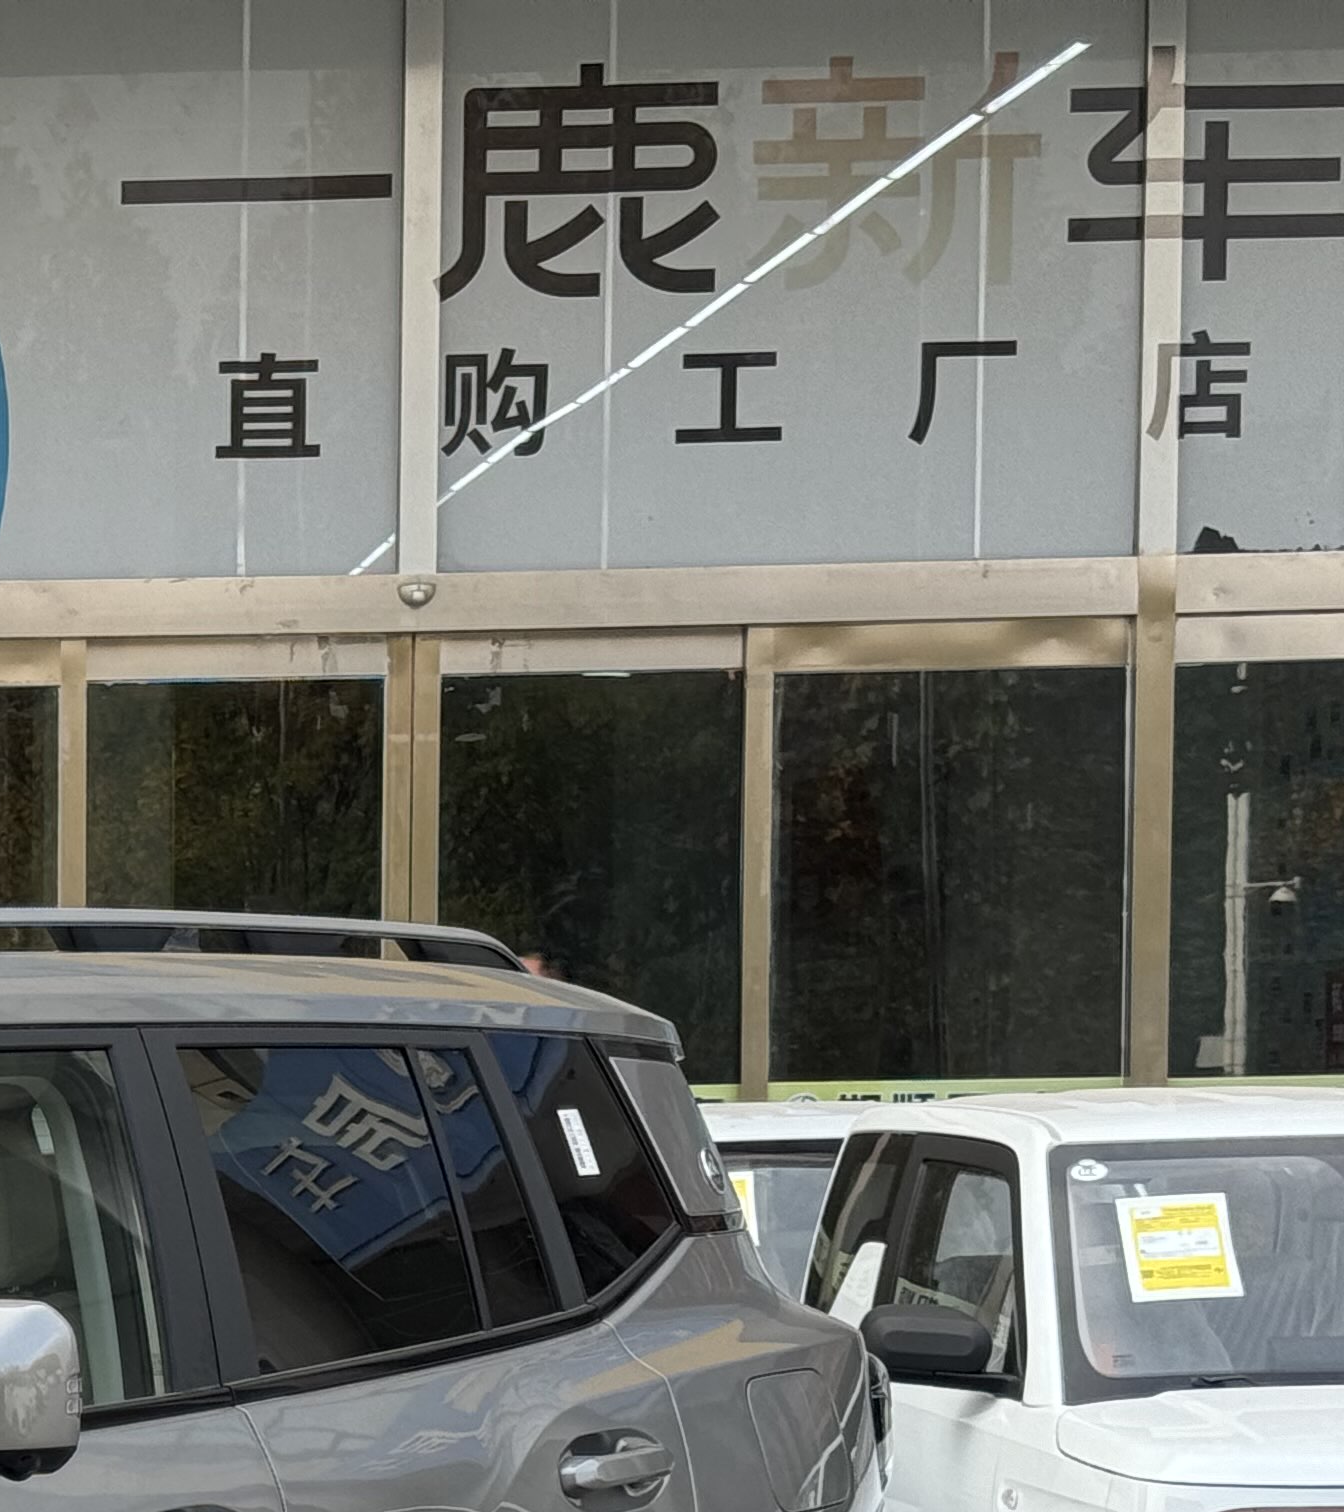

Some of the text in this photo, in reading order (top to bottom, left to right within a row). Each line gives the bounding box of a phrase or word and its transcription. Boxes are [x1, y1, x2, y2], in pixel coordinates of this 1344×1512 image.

[120, 45, 1344, 303] 一鹿新车
[215, 331, 1253, 459] 直购工厂店
